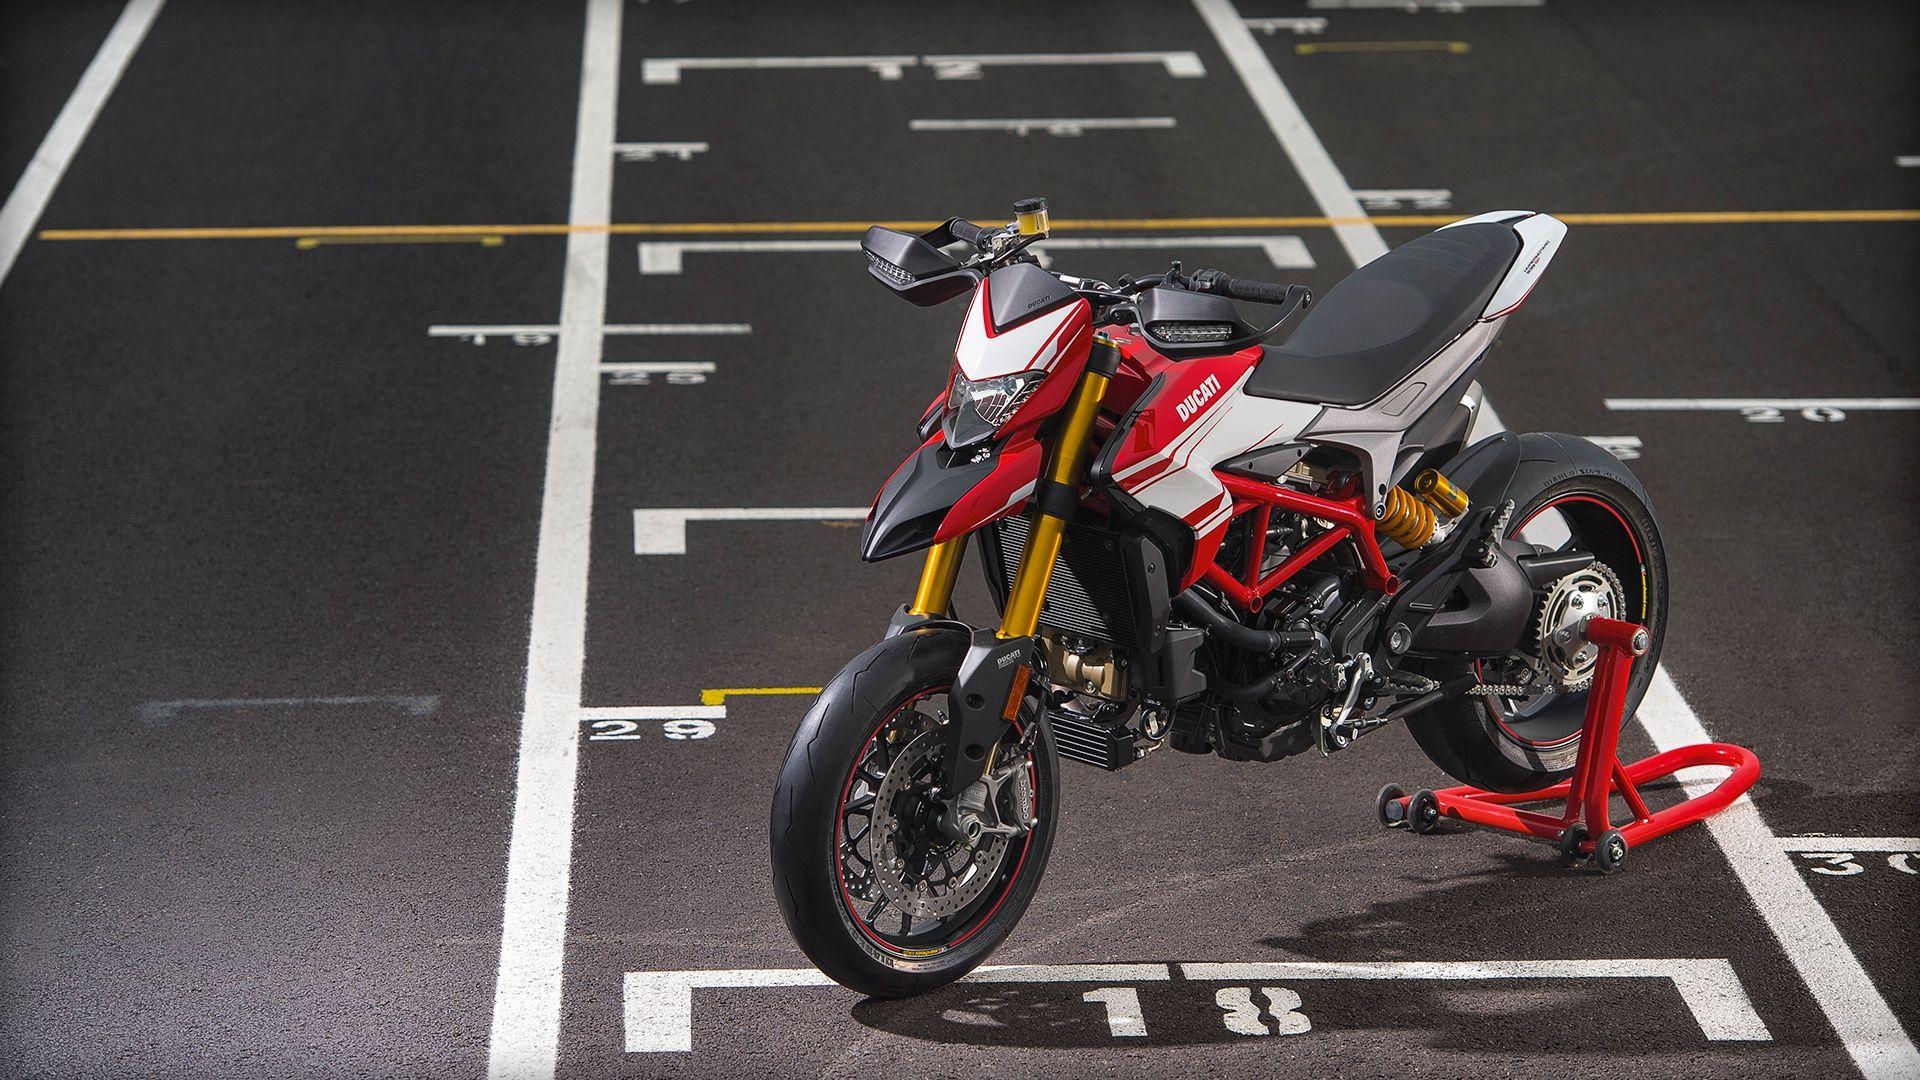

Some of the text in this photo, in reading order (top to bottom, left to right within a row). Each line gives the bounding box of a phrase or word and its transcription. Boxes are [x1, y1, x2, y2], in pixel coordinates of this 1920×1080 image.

[1027, 295, 1052, 309] DUCATI
[1175, 373, 1222, 423] DUCATI
[1739, 406, 1846, 424] 20
[589, 719, 716, 742] 29
[1082, 986, 1312, 1037] 18
